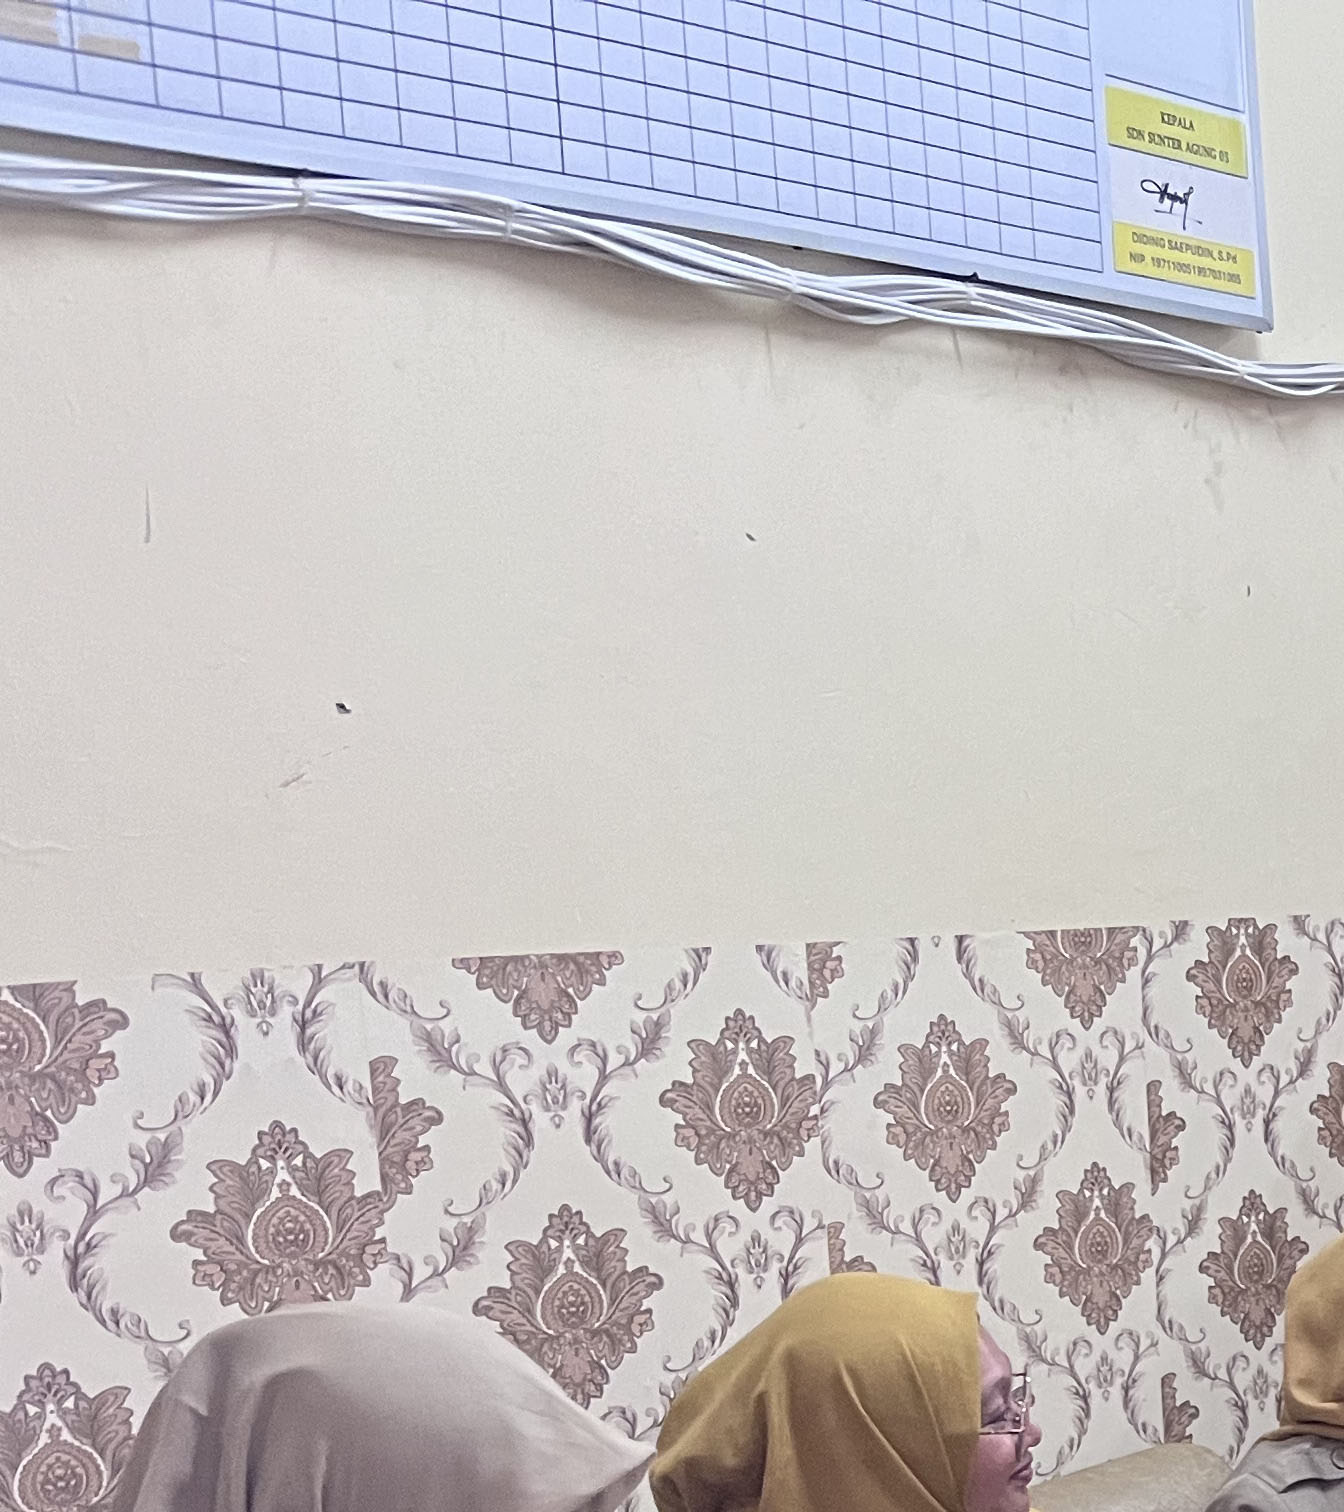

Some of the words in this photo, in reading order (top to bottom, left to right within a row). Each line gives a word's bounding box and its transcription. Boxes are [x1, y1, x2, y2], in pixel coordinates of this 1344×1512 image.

[1160, 111, 1195, 132] KEPALA
[1126, 126, 1145, 142] SDN
[1147, 131, 1183, 152] SUNTER
[1185, 141, 1217, 160] AGUNG
[1131, 231, 1166, 249] DIDING
